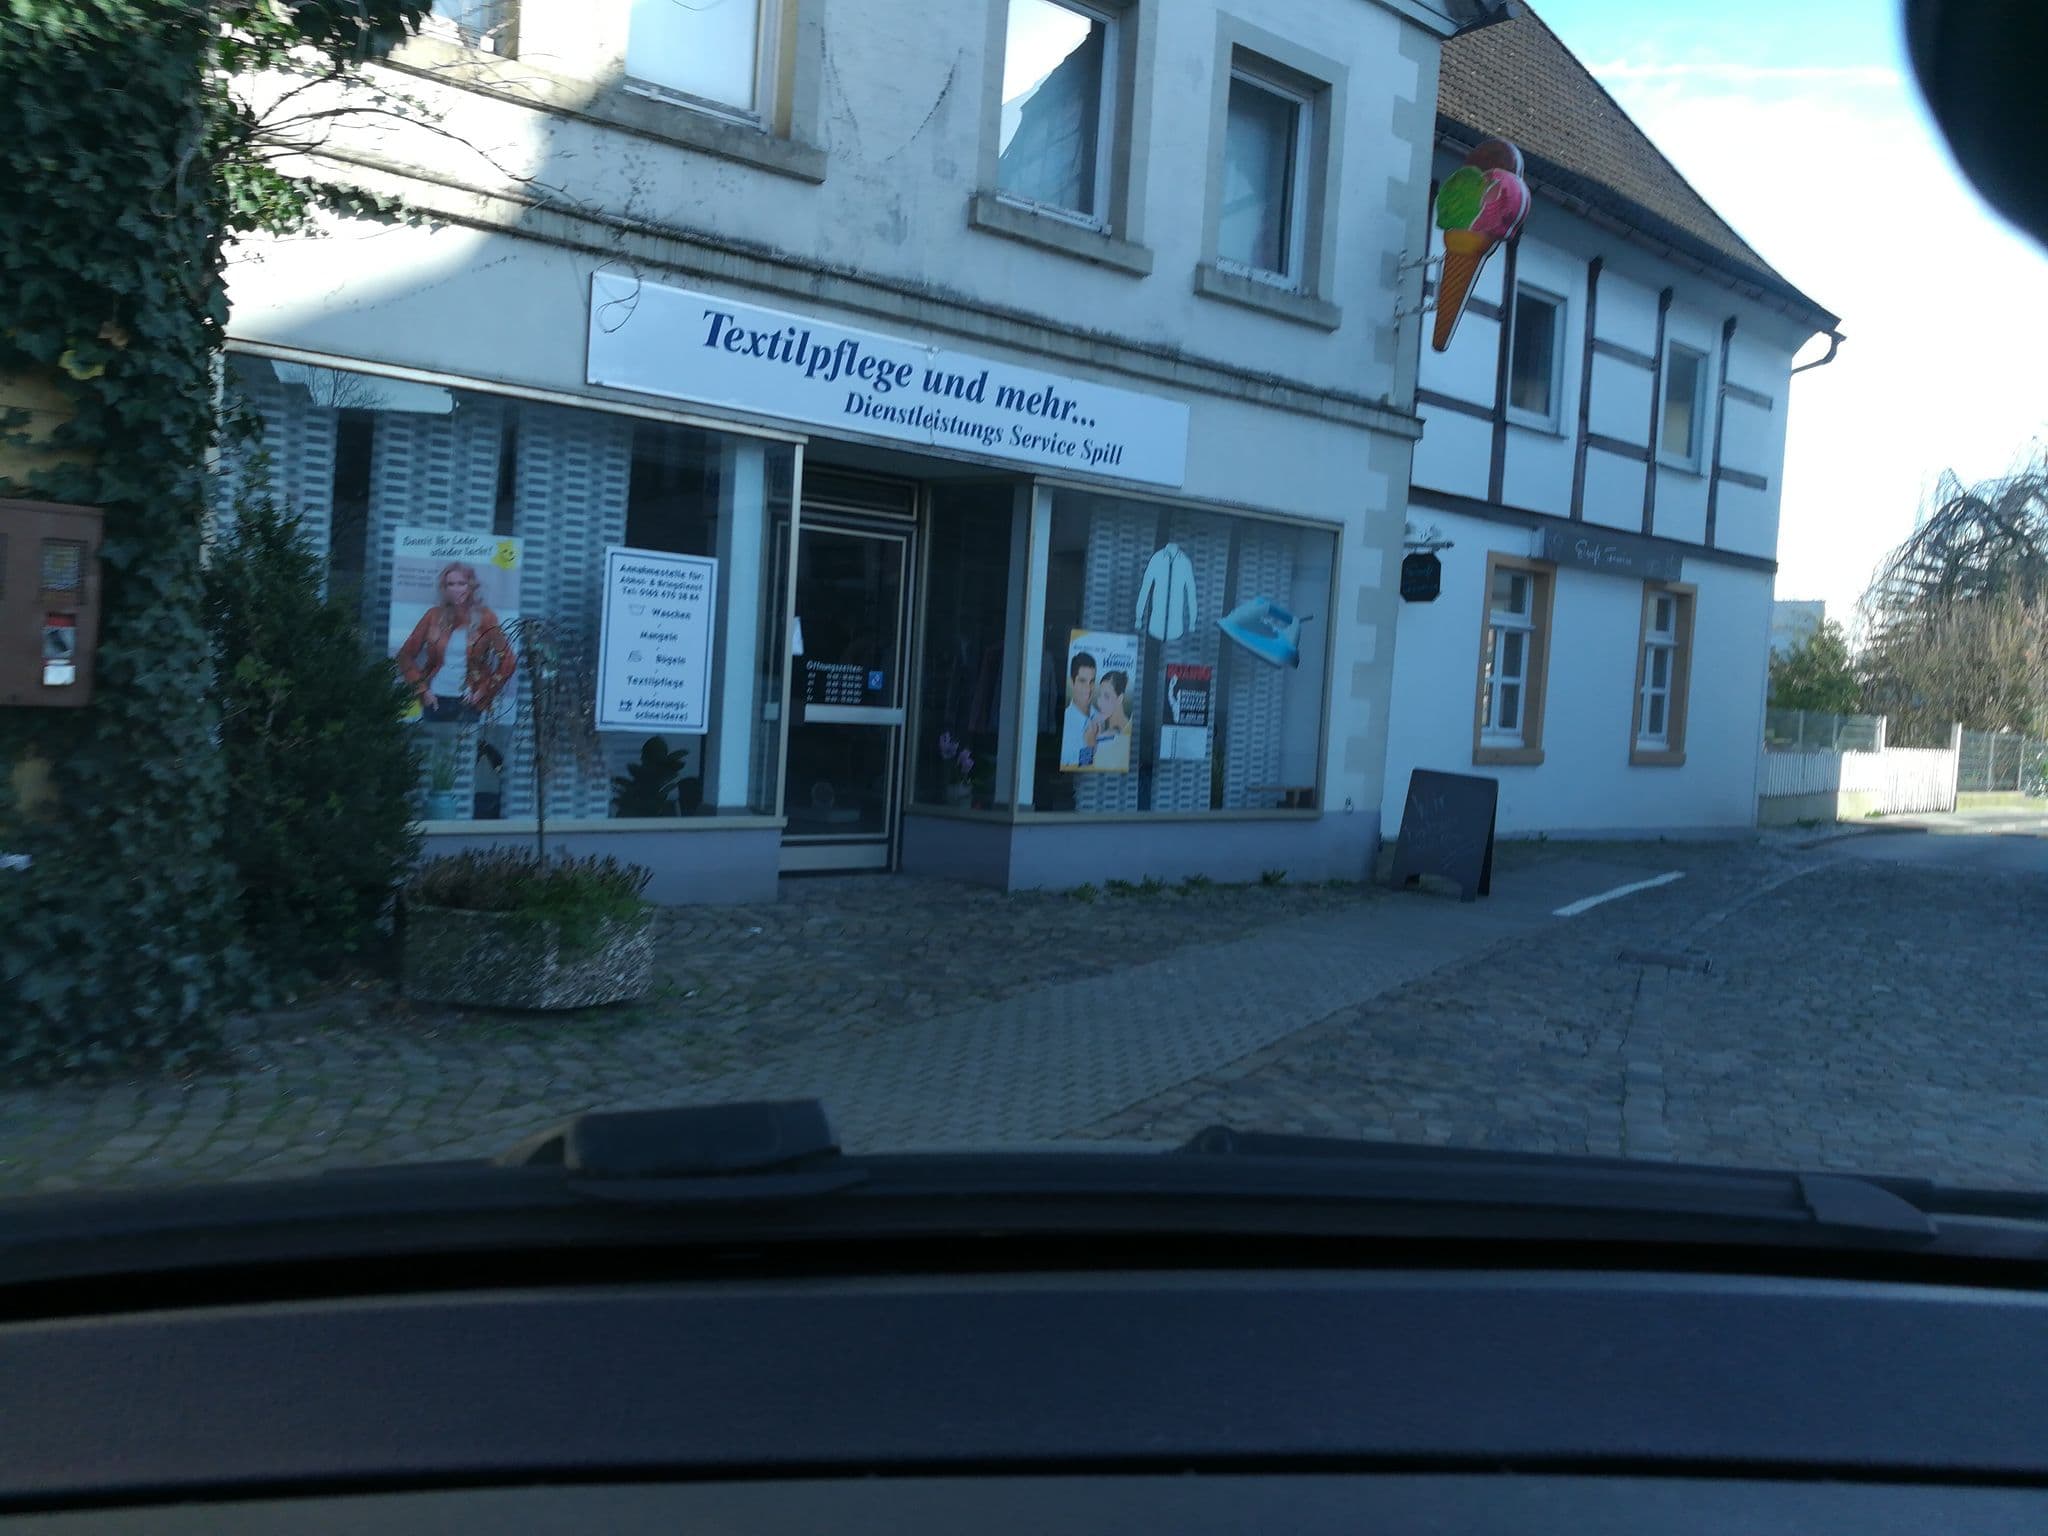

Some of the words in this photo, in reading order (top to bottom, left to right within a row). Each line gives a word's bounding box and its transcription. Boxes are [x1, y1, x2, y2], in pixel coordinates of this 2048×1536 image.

[703, 309, 913, 393] Textilpflege
[922, 367, 989, 404] und
[996, 385, 1097, 428] mehr...
[844, 393, 1004, 444] Dienstleistungs
[1009, 425, 1076, 459] Service
[1080, 440, 1124, 467] Spill
[651, 607, 692, 620] Waschen
[626, 675, 685, 690] Textilpflege
